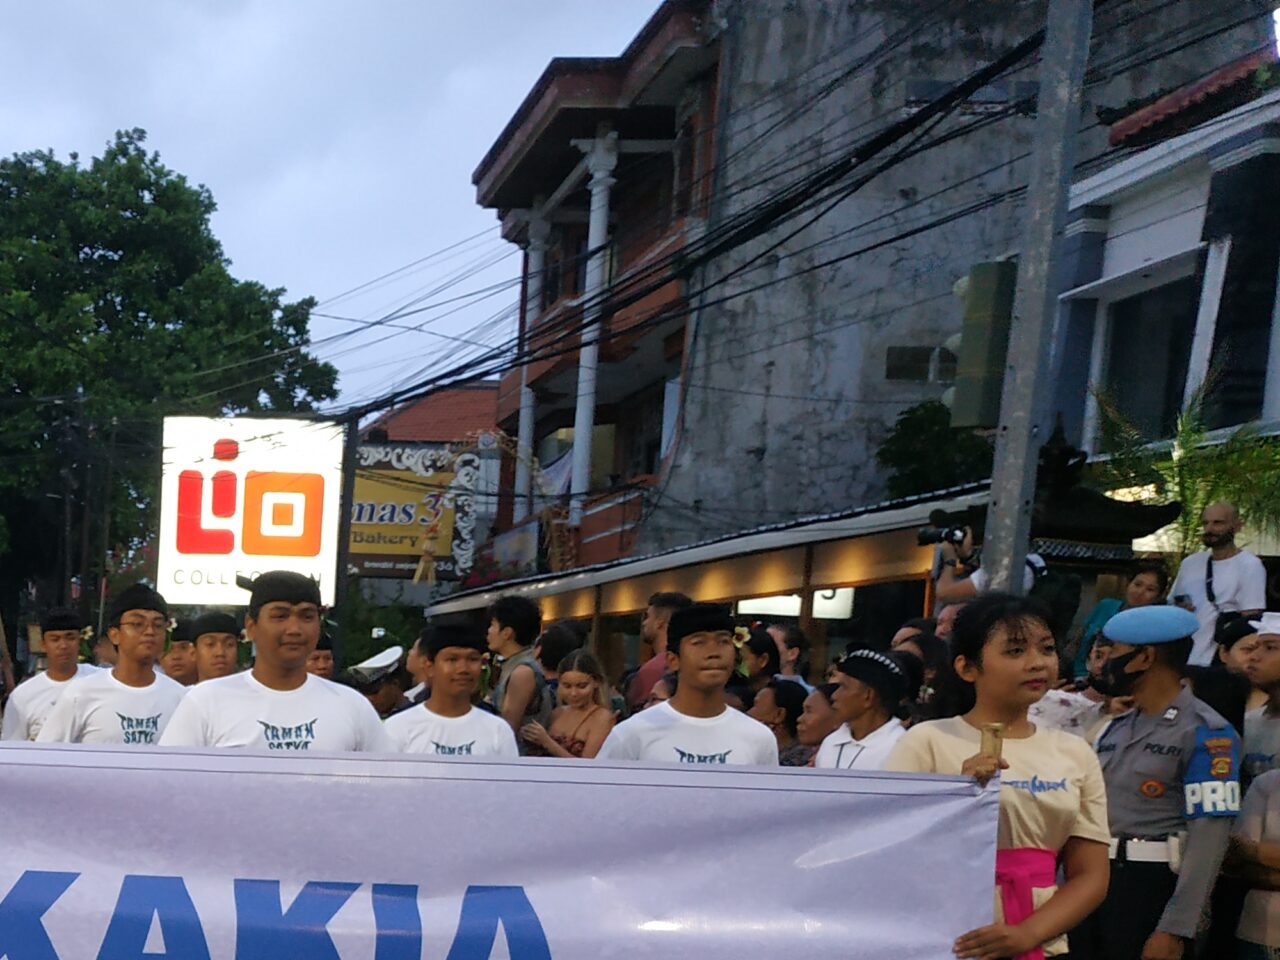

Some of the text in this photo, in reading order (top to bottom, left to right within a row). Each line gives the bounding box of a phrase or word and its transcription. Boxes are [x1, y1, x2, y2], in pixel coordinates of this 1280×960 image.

[351, 532, 420, 548] Bakery
[256, 717, 318, 741] TAMAN
[1143, 742, 1183, 757] POLRI
[1184, 780, 1241, 816] PRO
